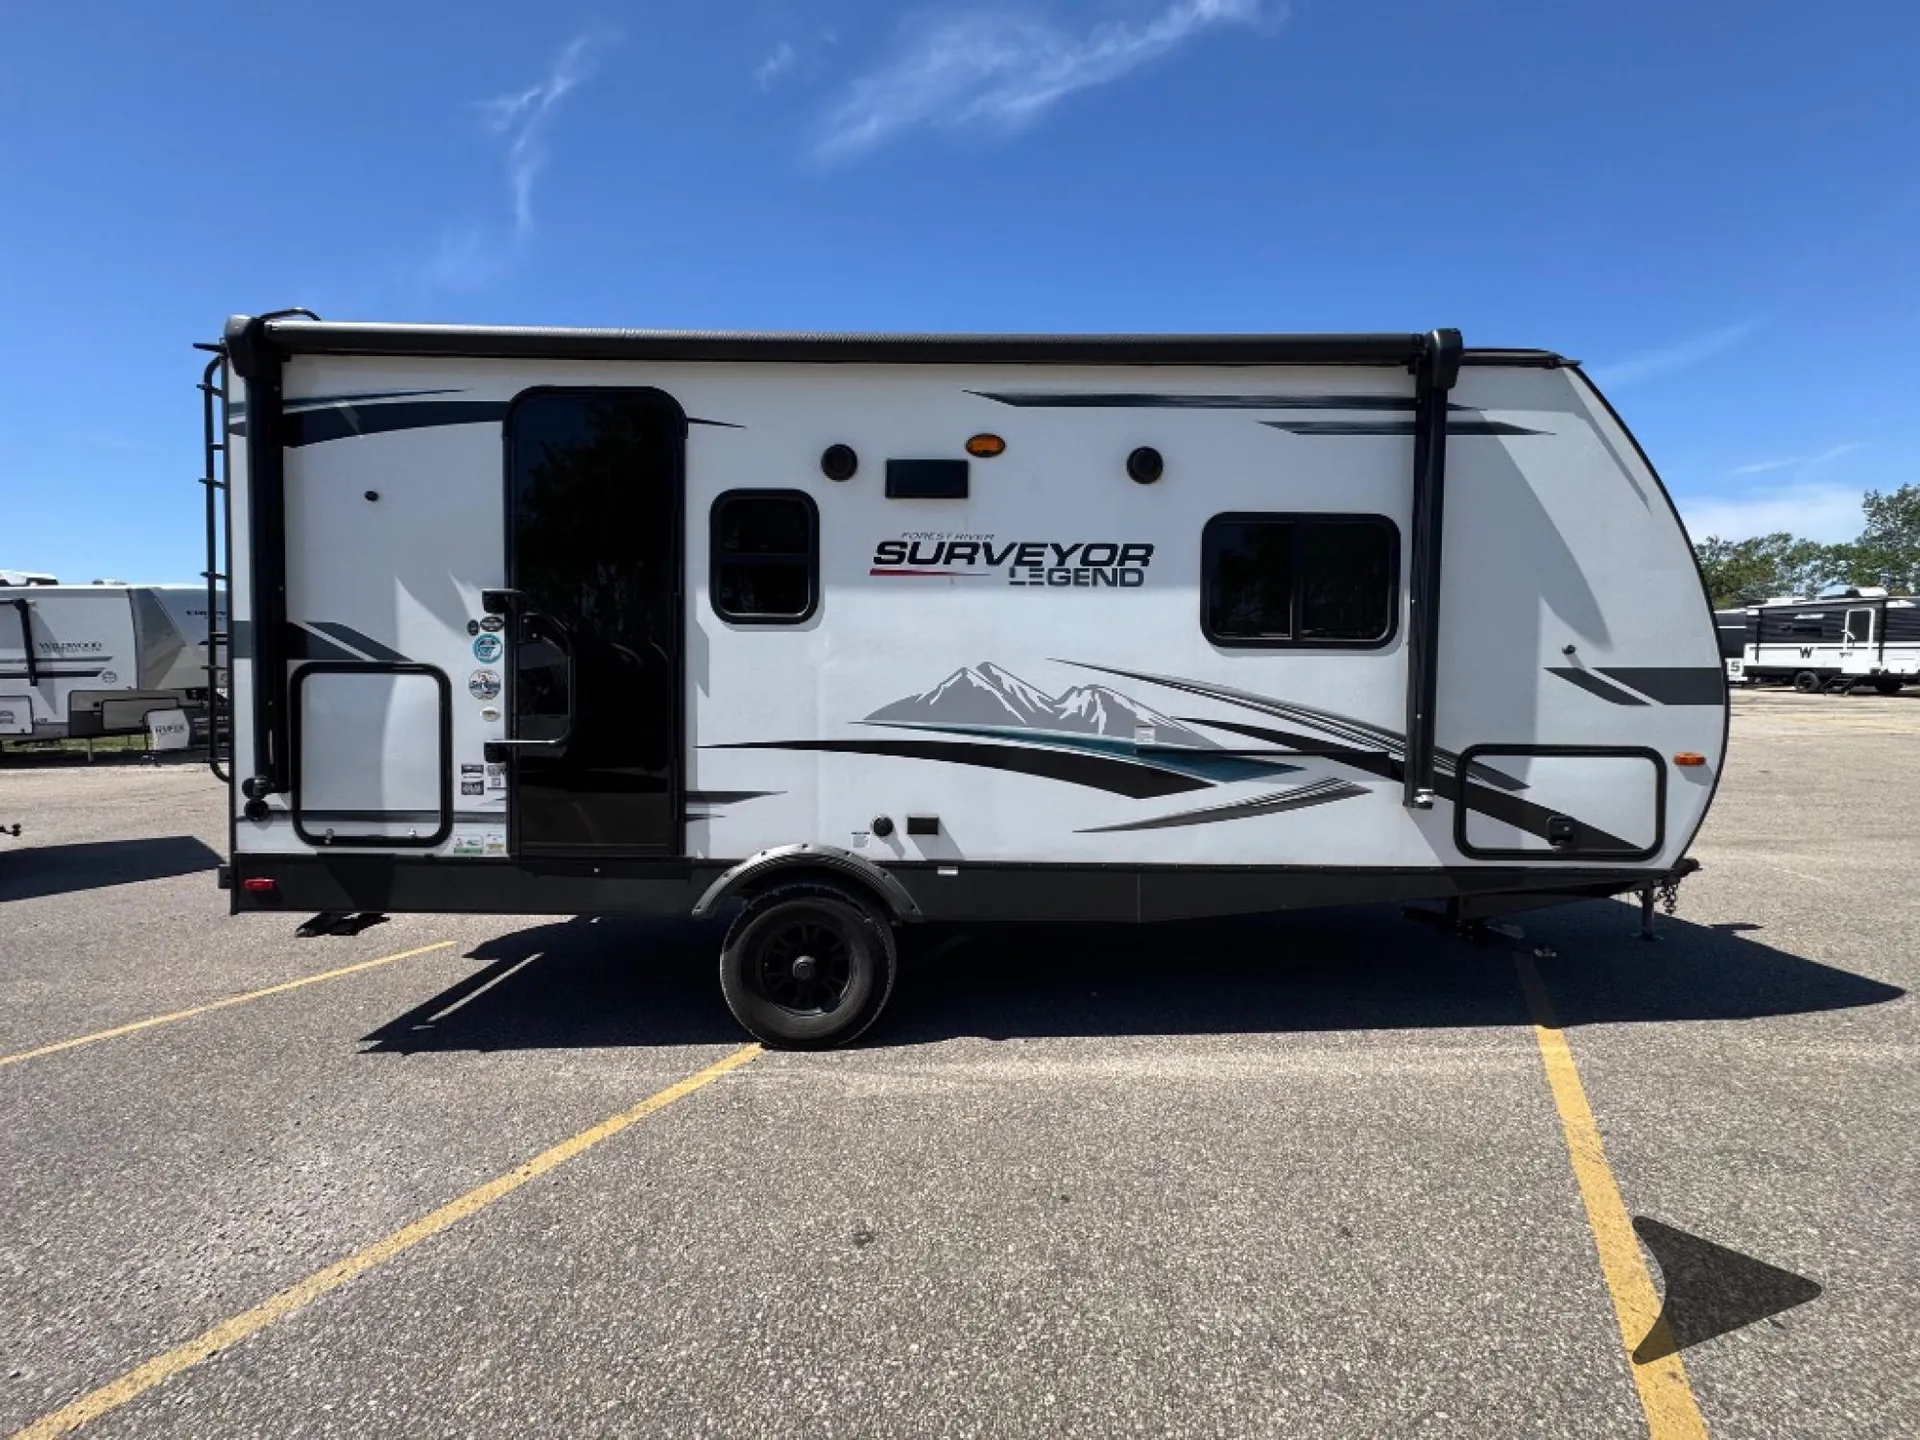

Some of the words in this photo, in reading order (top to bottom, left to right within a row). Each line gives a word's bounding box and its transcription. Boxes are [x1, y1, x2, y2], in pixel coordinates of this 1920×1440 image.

[873, 541, 1155, 567] SURVEYOR
[1008, 567, 1145, 587] LEGEND
[1800, 646, 1812, 659] W
